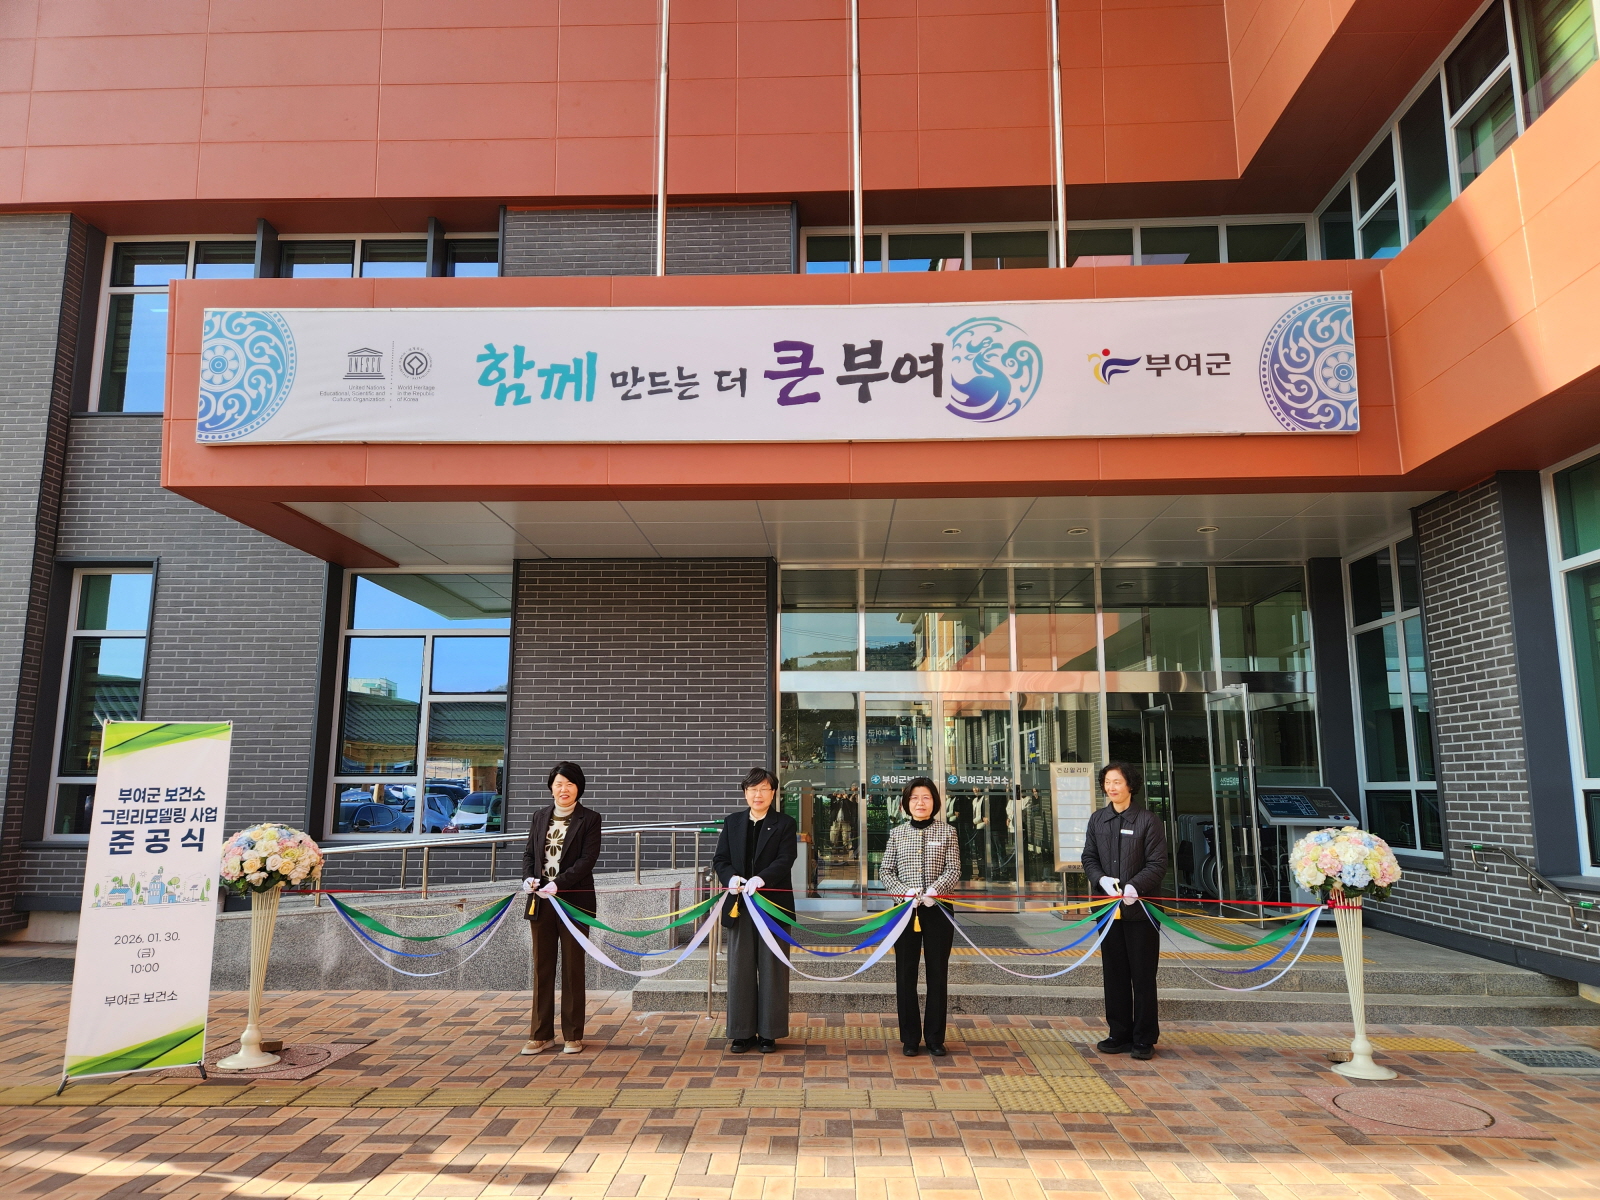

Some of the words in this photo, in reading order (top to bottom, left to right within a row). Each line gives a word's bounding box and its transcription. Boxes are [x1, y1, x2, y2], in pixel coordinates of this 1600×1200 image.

[348, 356, 383, 373] UNESCO
[1144, 352, 1232, 377] 부여군
[476, 342, 598, 407] 함께
[610, 365, 700, 401] 만드는
[713, 366, 748, 398] 더
[763, 339, 825, 407] 큰
[835, 339, 944, 404] 부여
[412, 390, 435, 398] Republic
[413, 384, 436, 392] Heritage
[352, 396, 386, 404] Organization
[882, 775, 929, 784] 부여군보
[959, 775, 1009, 785] 부여군보건소
[117, 787, 161, 804] 부여군
[164, 786, 206, 803] 보건소
[100, 807, 187, 826] 그린리모델링
[189, 806, 218, 823] 사업
[113, 934, 145, 946] 2026.
[147, 932, 162, 943] 01.
[164, 931, 181, 942] 30.
[136, 947, 156, 959] (금)
[130, 962, 160, 974] 10:00
[104, 993, 140, 1007] 부여군
[143, 990, 178, 1004] 보건소
